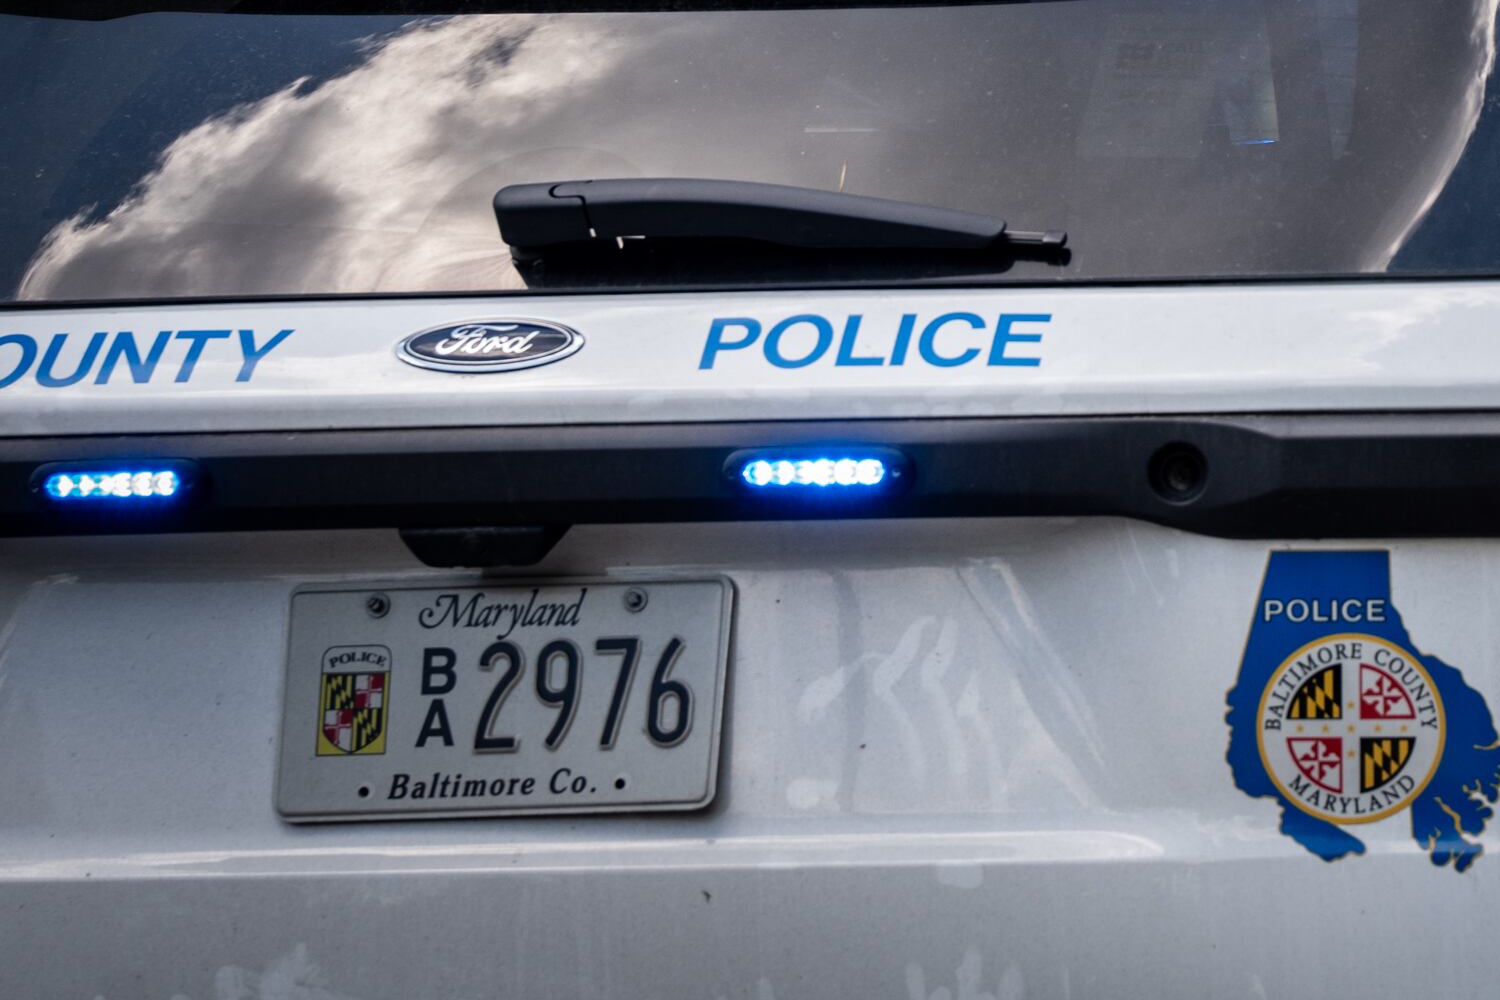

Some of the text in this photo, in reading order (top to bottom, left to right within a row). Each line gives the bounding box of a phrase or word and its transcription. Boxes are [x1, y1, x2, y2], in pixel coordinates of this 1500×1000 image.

[435, 324, 540, 355] Ford
[698, 312, 1053, 370] POLICE
[419, 588, 587, 639] Maryland
[1263, 599, 1386, 623] POLICE
[329, 651, 387, 668] POLICE
[474, 636, 694, 753] 2976
[1265, 642, 1439, 731] BALTIMORE COUNTY
[387, 768, 597, 801] Baltimore Co.
[1288, 774, 1416, 815] MARYLAND
